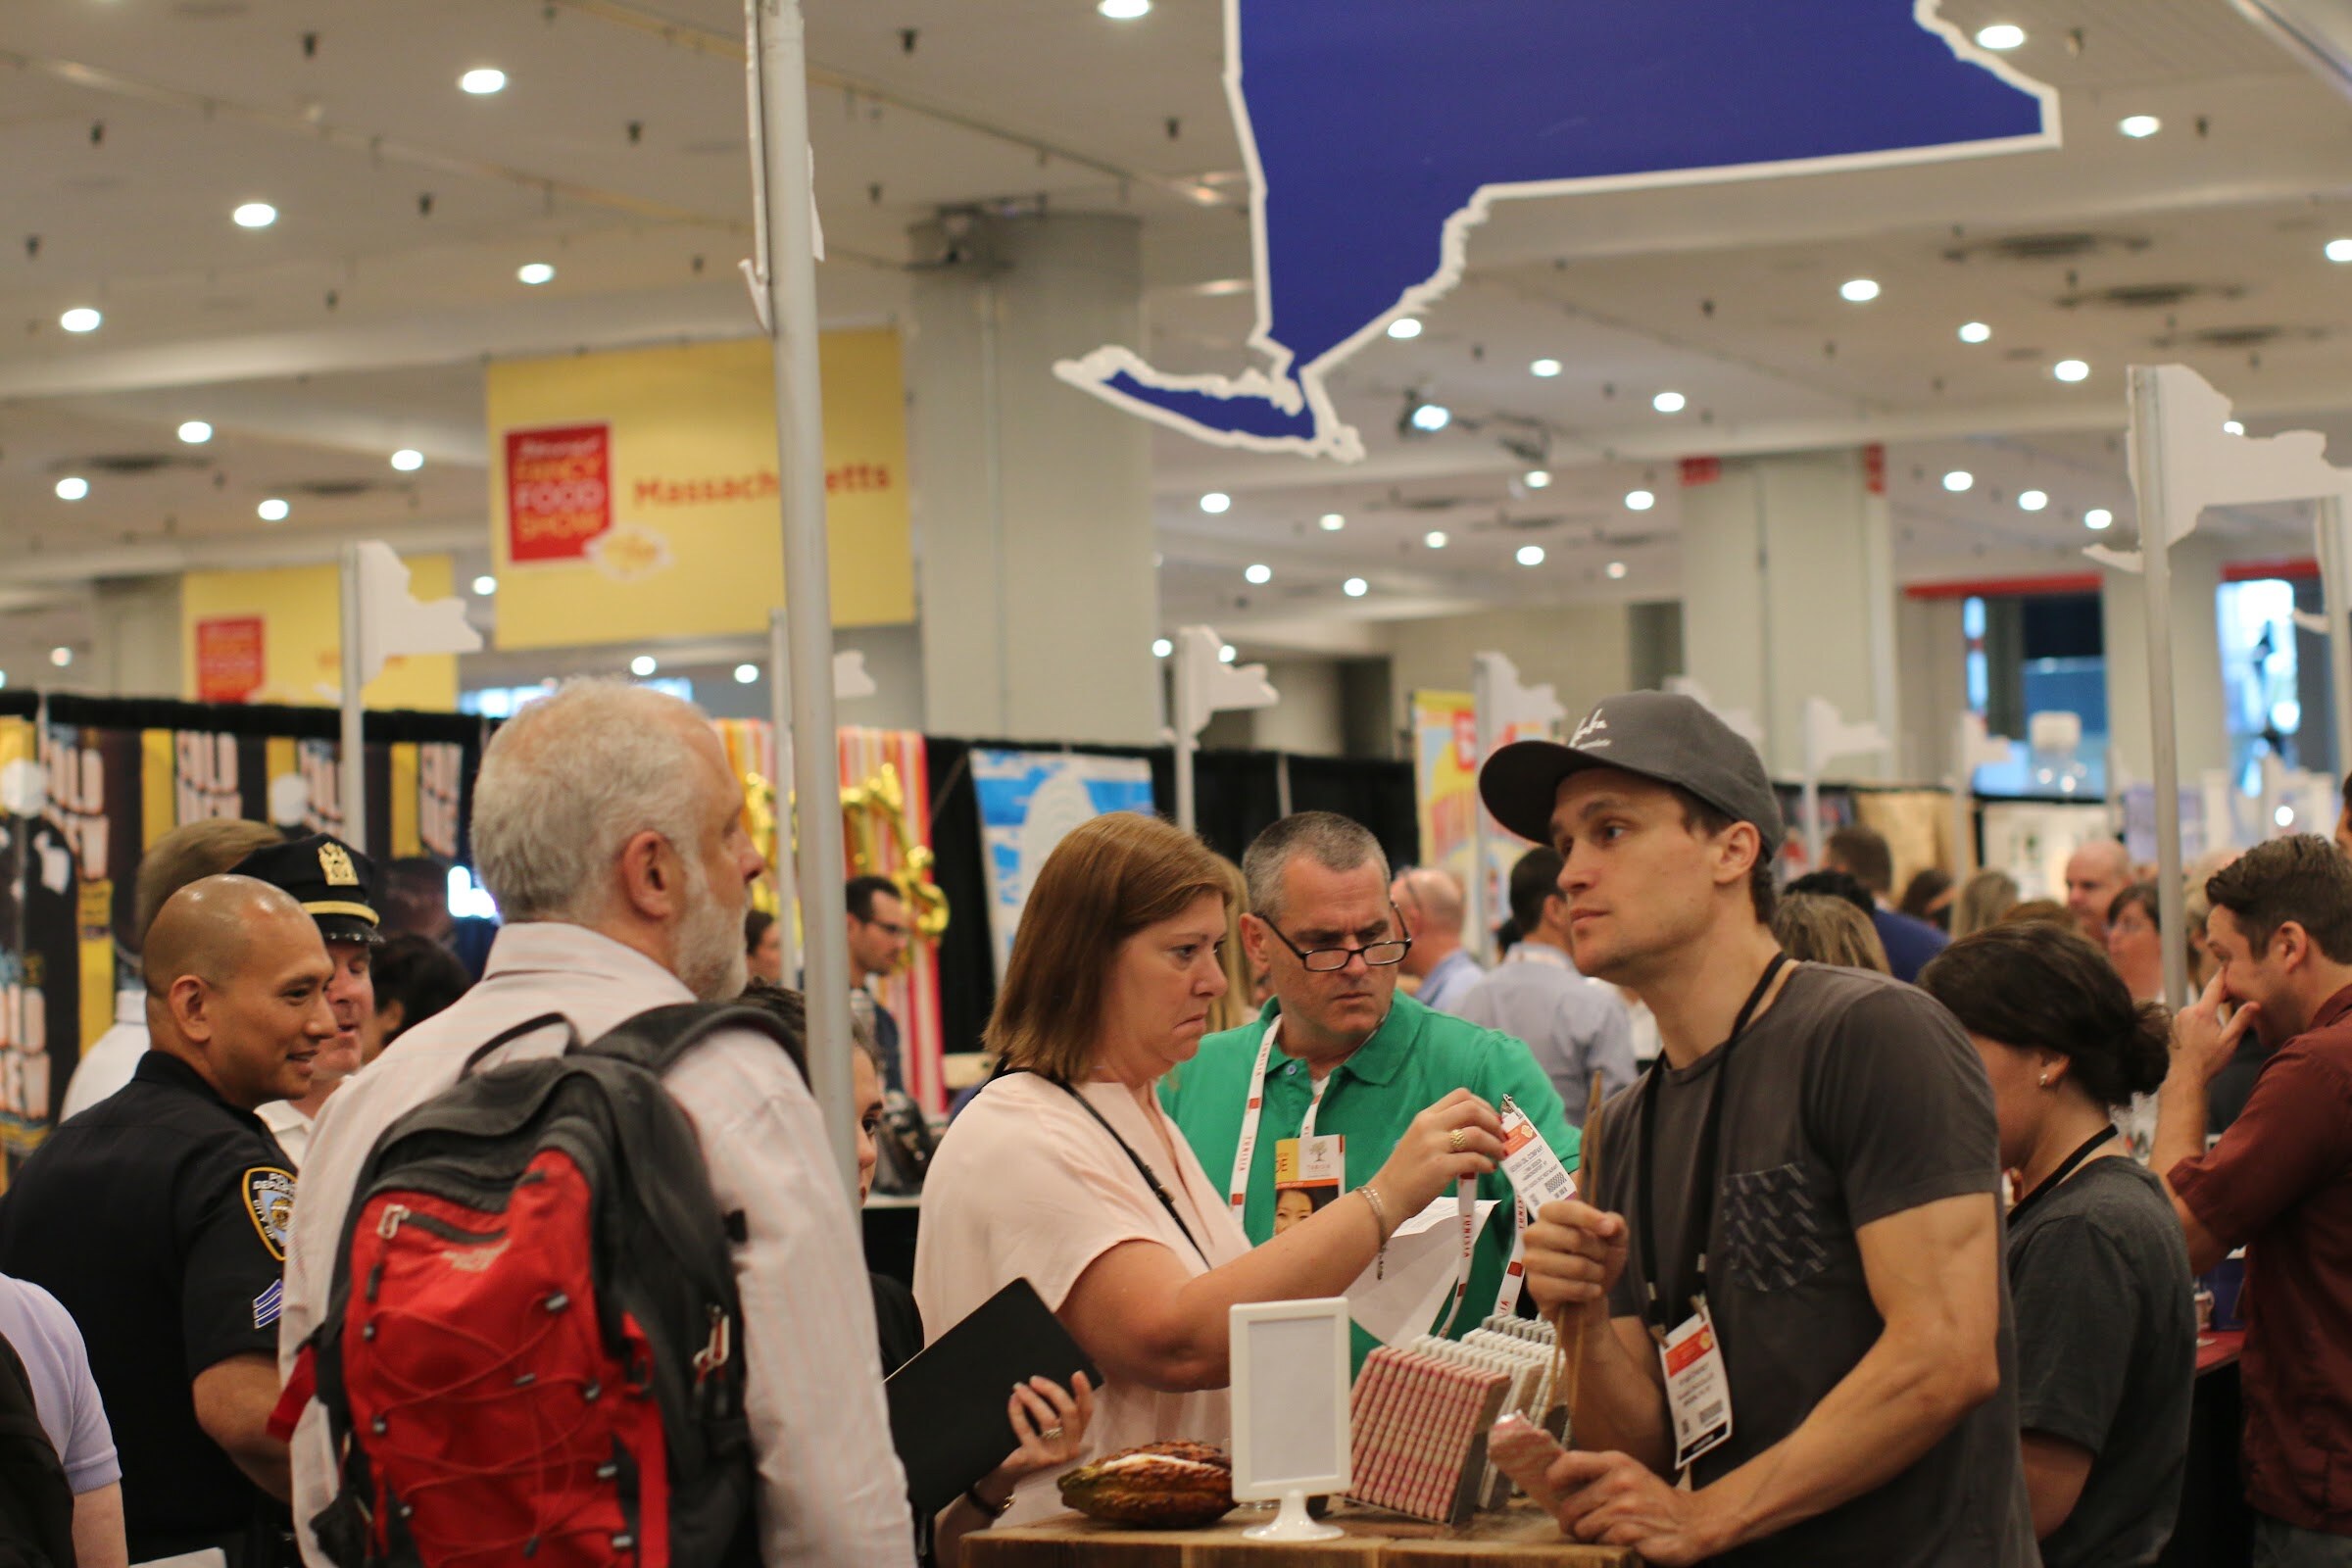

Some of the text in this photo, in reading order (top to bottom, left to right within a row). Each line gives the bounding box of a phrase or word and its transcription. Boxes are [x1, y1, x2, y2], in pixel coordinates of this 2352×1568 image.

[514, 478, 605, 514] FOOD
[634, 464, 891, 507] Massachetts
[1254, 1042, 1270, 1076] TUNISIA
[1238, 1136, 1253, 1172] TUNISIA
[1462, 1214, 1473, 1258] TUNISIA
